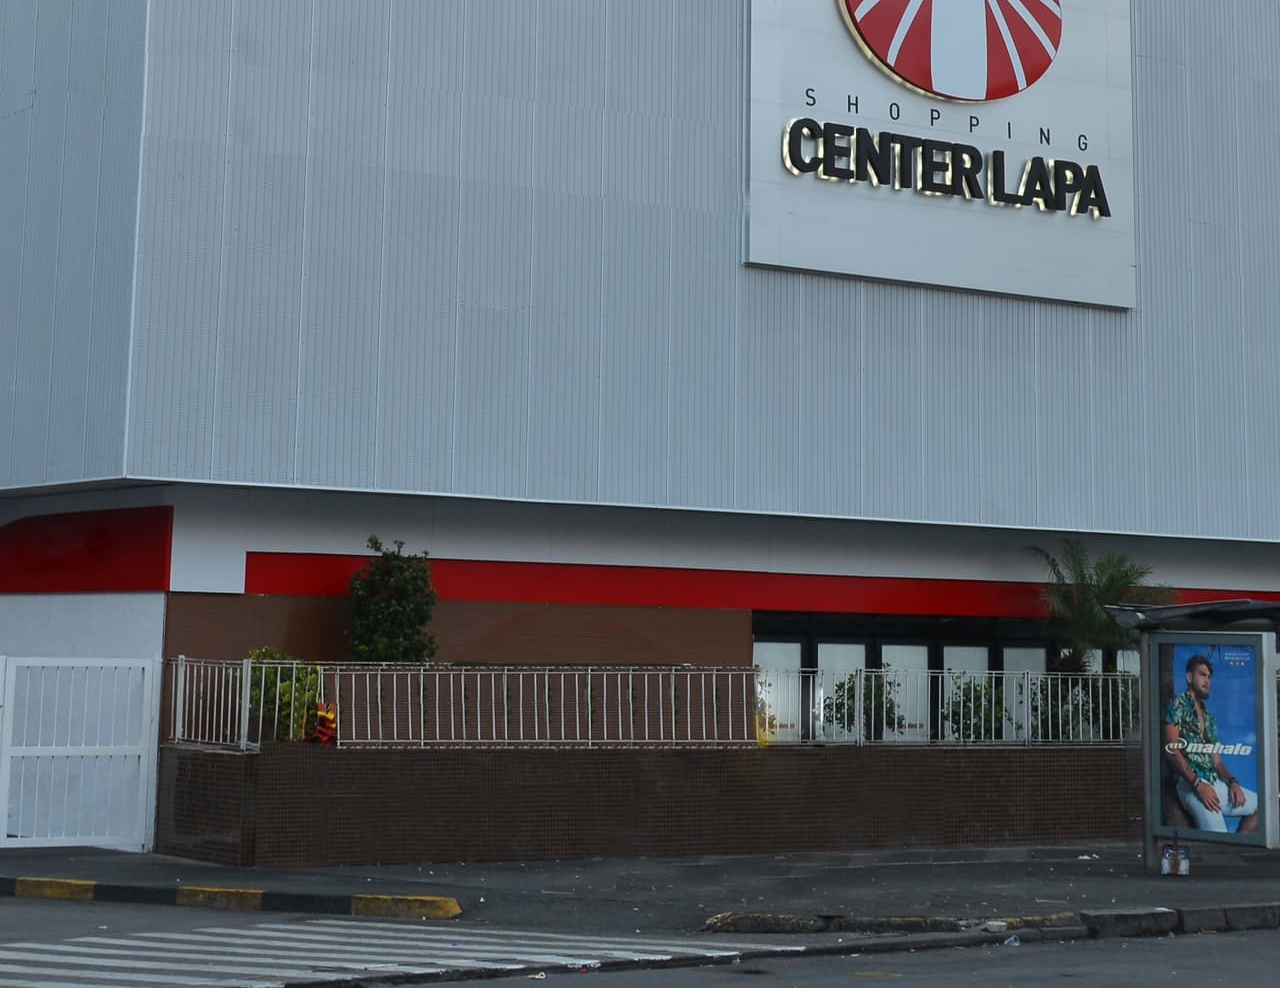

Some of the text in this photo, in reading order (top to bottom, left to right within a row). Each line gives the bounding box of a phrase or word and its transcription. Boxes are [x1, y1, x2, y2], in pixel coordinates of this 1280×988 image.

[804, 87, 1089, 152] SHOPPING
[784, 117, 1112, 220] CENTER LAPA
[1186, 741, 1253, 756] mahalo
